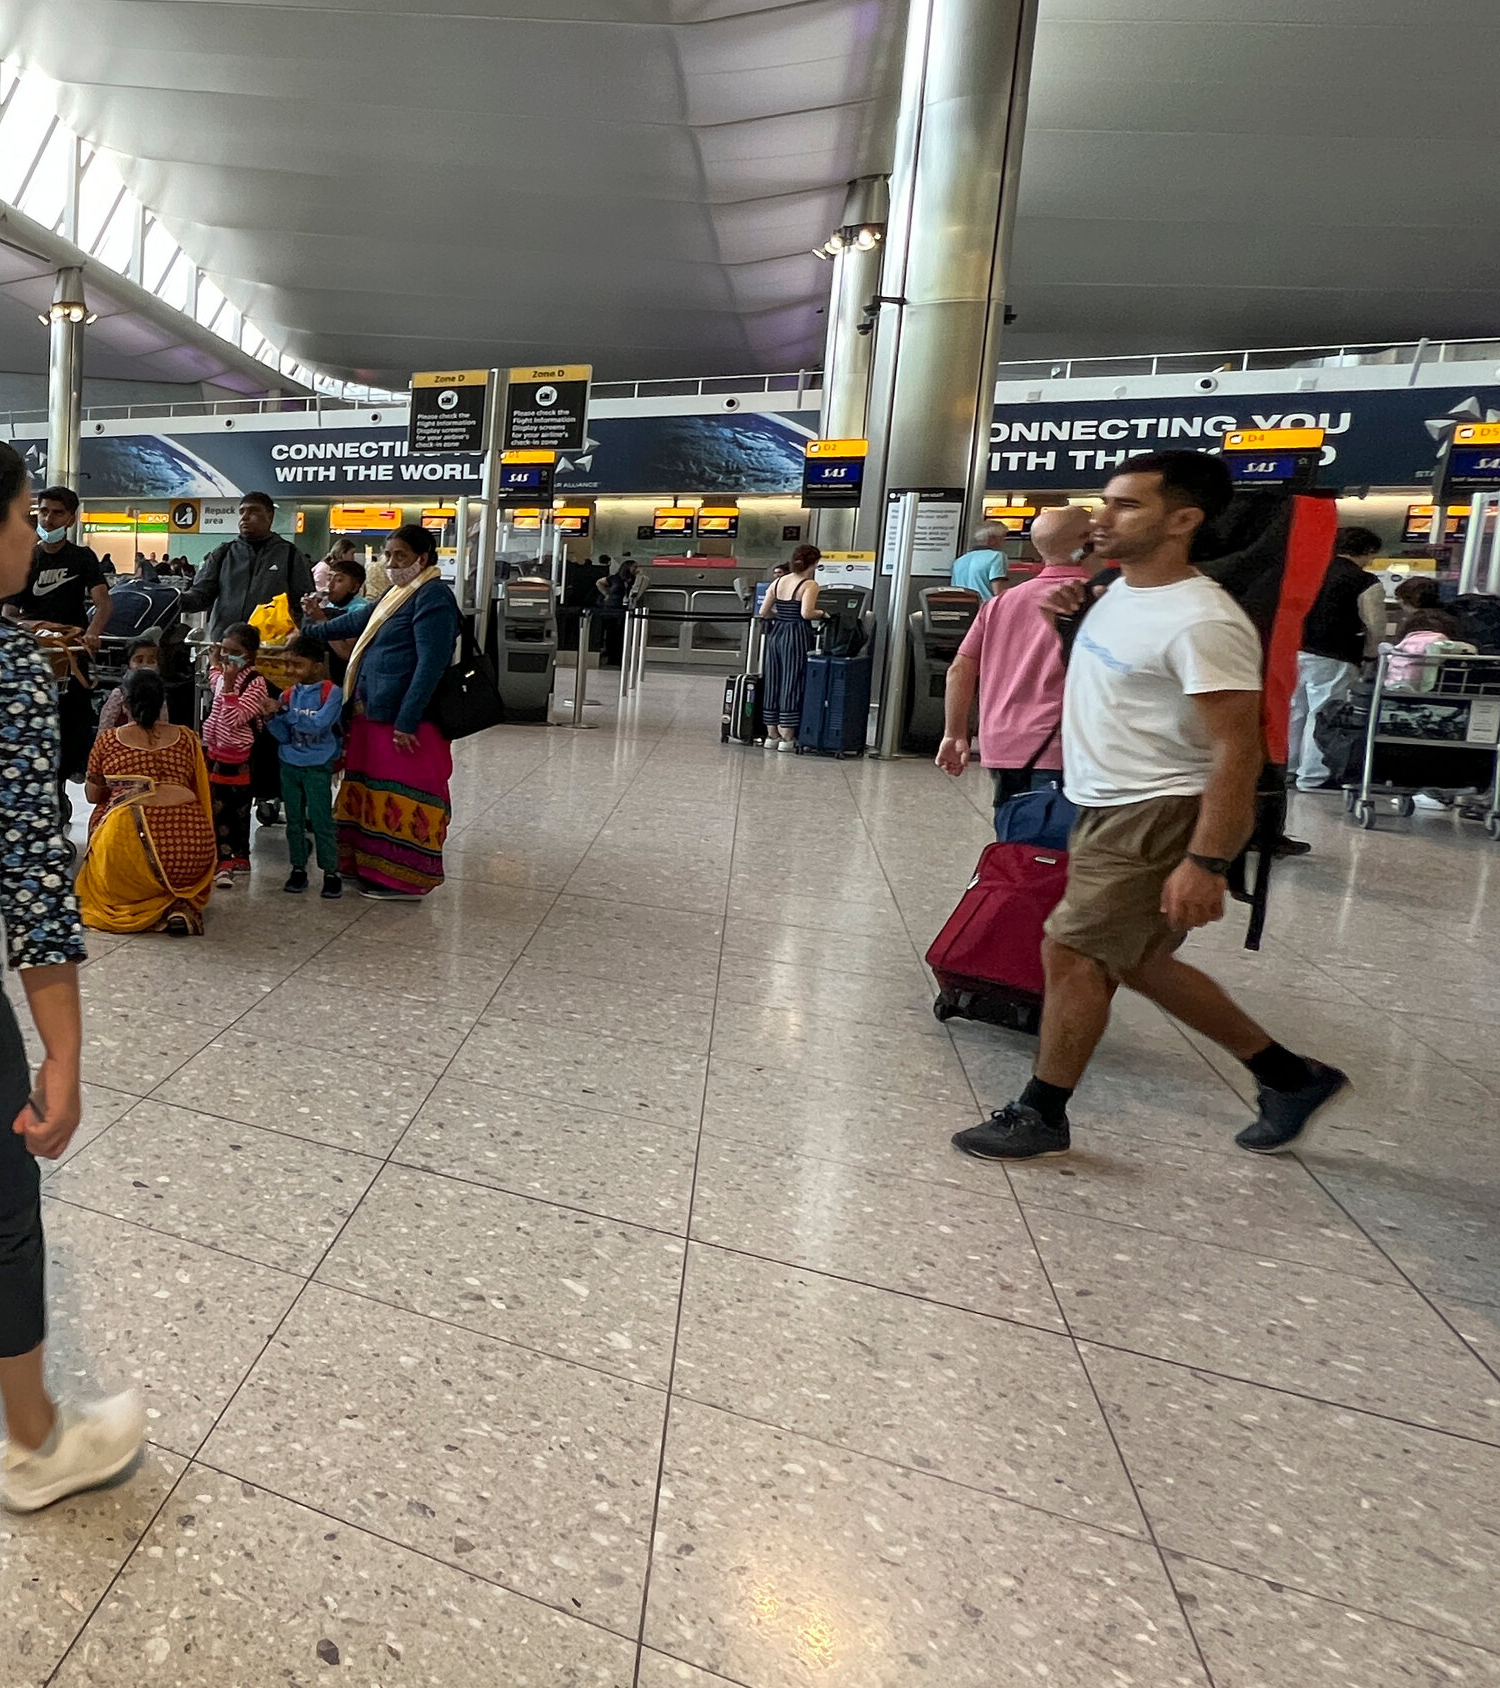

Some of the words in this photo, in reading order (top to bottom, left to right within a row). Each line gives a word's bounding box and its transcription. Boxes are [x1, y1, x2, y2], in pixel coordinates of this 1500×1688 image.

[434, 374, 456, 383] Zone
[457, 374, 465, 382] D
[532, 370, 555, 378] Zone
[557, 369, 565, 378] D
[989, 414, 1238, 443] ONNECTING
[1251, 412, 1351, 434] YOU
[271, 440, 409, 461] CONNECTI
[988, 450, 1057, 472] ITH
[1242, 461, 1278, 473] SAS
[1472, 457, 1500, 469] SA
[275, 466, 337, 482] WITH
[342, 464, 394, 481] THE
[508, 473, 529, 483] SAS
[821, 467, 848, 478] SAS
[204, 506, 235, 516] Repack
[204, 516, 223, 524] area
[38, 567, 69, 585] NIKE
